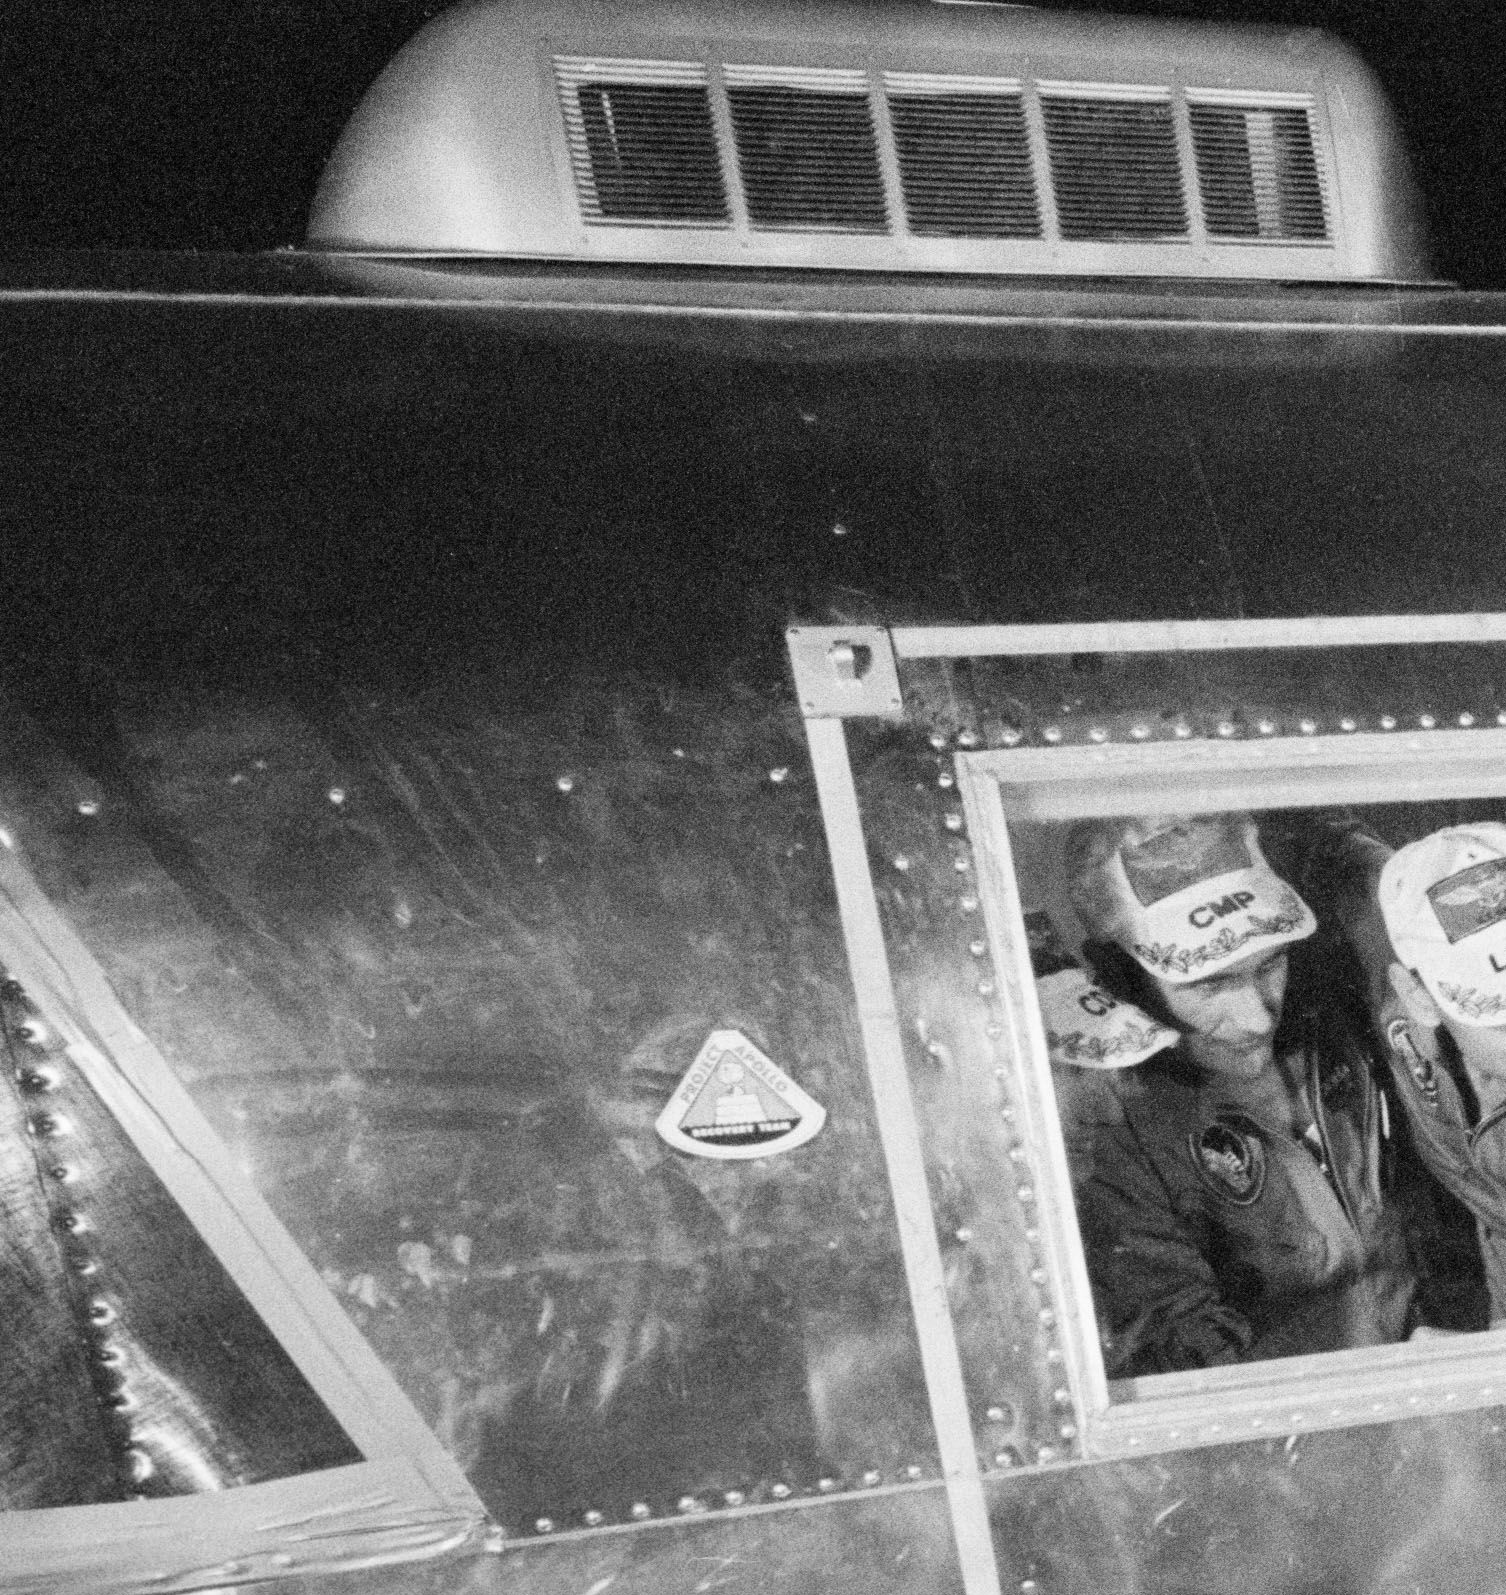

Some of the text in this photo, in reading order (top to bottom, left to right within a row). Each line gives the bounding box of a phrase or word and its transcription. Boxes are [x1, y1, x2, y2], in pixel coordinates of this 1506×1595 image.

[1188, 891, 1256, 929] CMP
[680, 1043, 722, 1103] PROJECT
[735, 1046, 788, 1092] APOLLO
